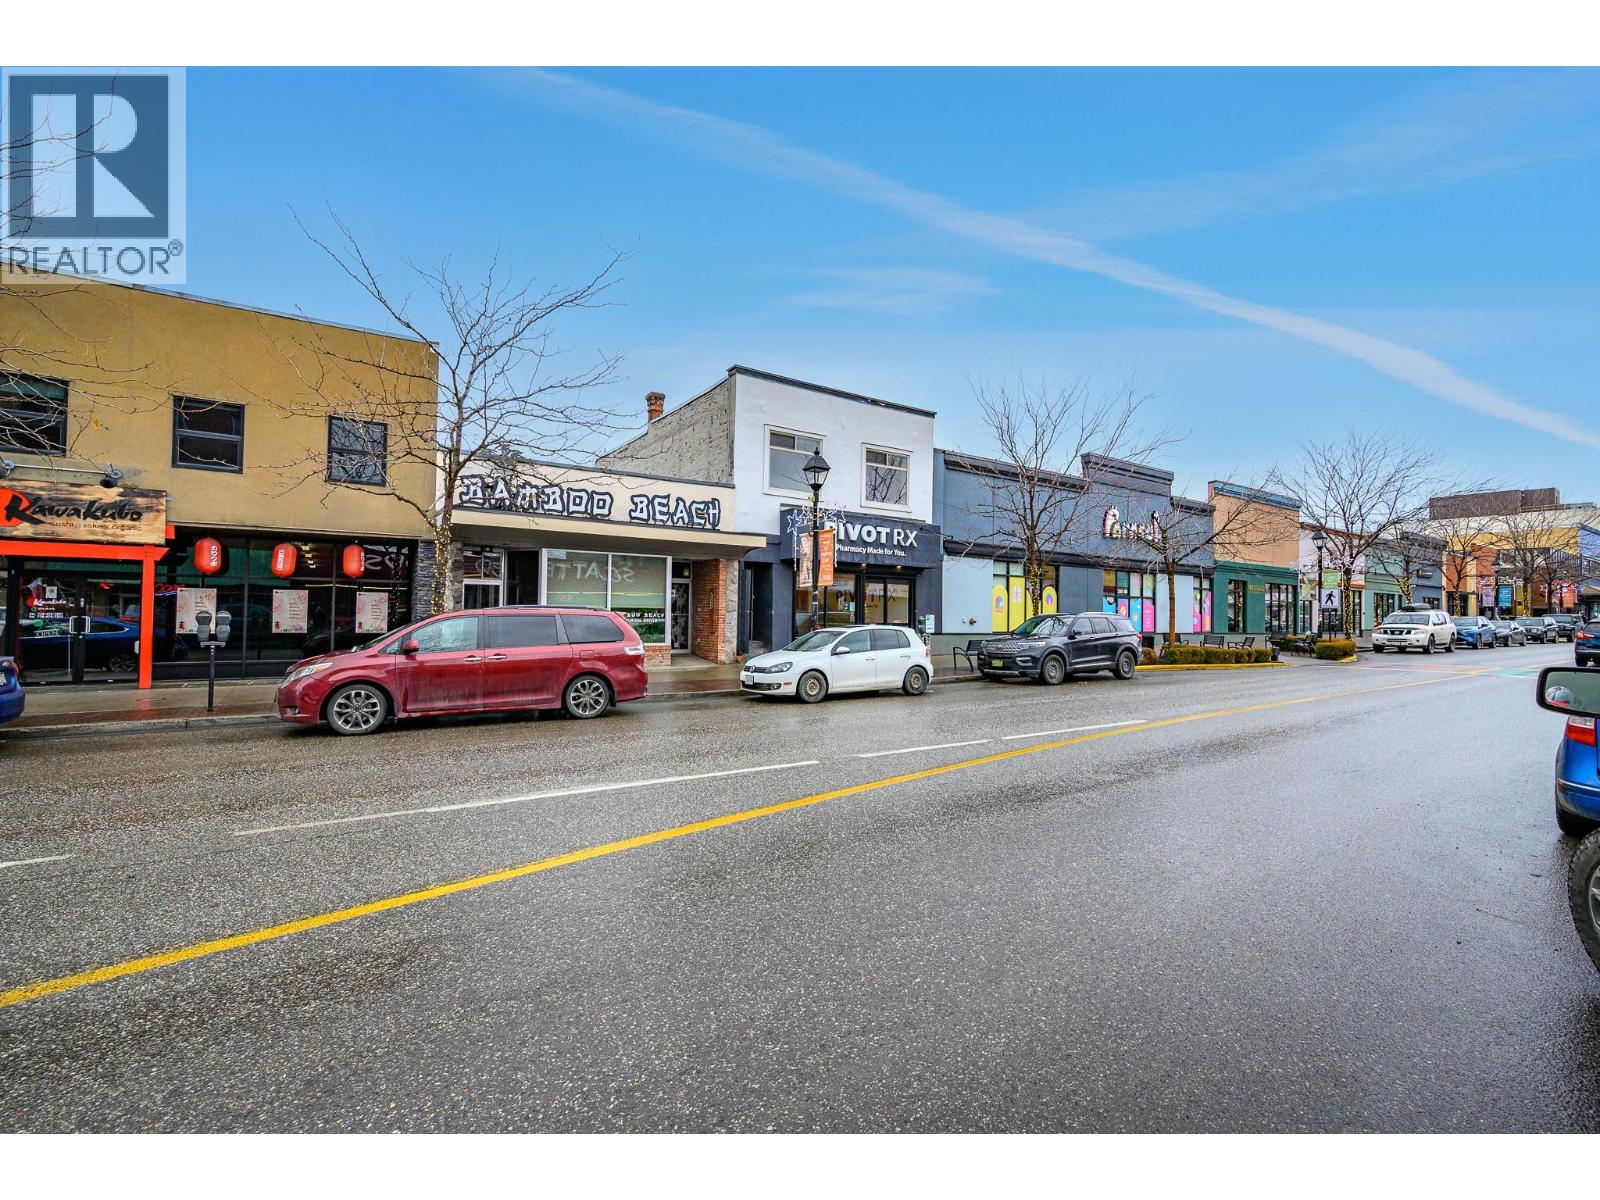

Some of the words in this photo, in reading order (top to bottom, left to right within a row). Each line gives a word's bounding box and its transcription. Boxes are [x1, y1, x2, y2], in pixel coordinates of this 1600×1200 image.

[4, 494, 144, 525] Kawakubo
[459, 475, 615, 518] BAMBOO
[629, 493, 721, 530] BEACH
[836, 543, 867, 555] Pharmacy
[867, 546, 885, 556] Made
[885, 547, 893, 556] for
[894, 548, 907, 557] You.
[893, 528, 918, 548] RX
